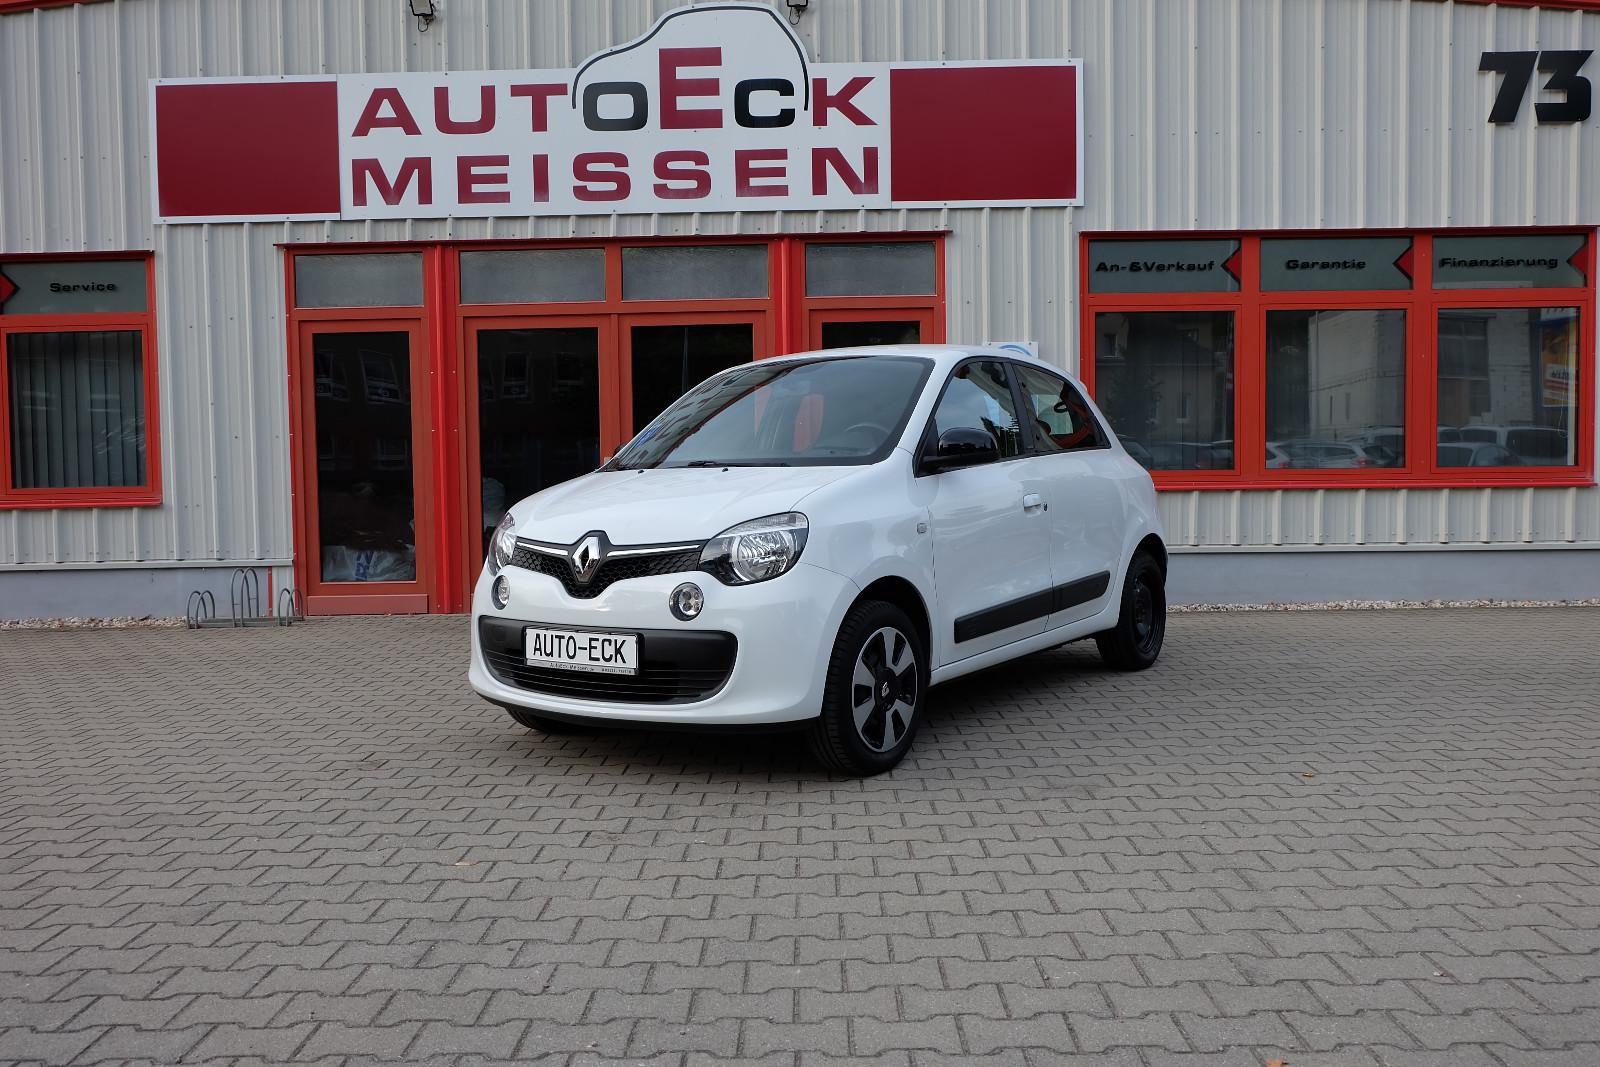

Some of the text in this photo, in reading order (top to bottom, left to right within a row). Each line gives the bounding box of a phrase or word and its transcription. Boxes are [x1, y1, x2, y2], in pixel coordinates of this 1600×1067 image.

[1478, 50, 1595, 124] 73
[351, 147, 879, 206] MEISSEN
[1285, 259, 1367, 270] Garantie
[1439, 256, 1559, 269] Finanzierung
[49, 282, 117, 293] Service
[533, 632, 627, 664] AUTO-ECK
